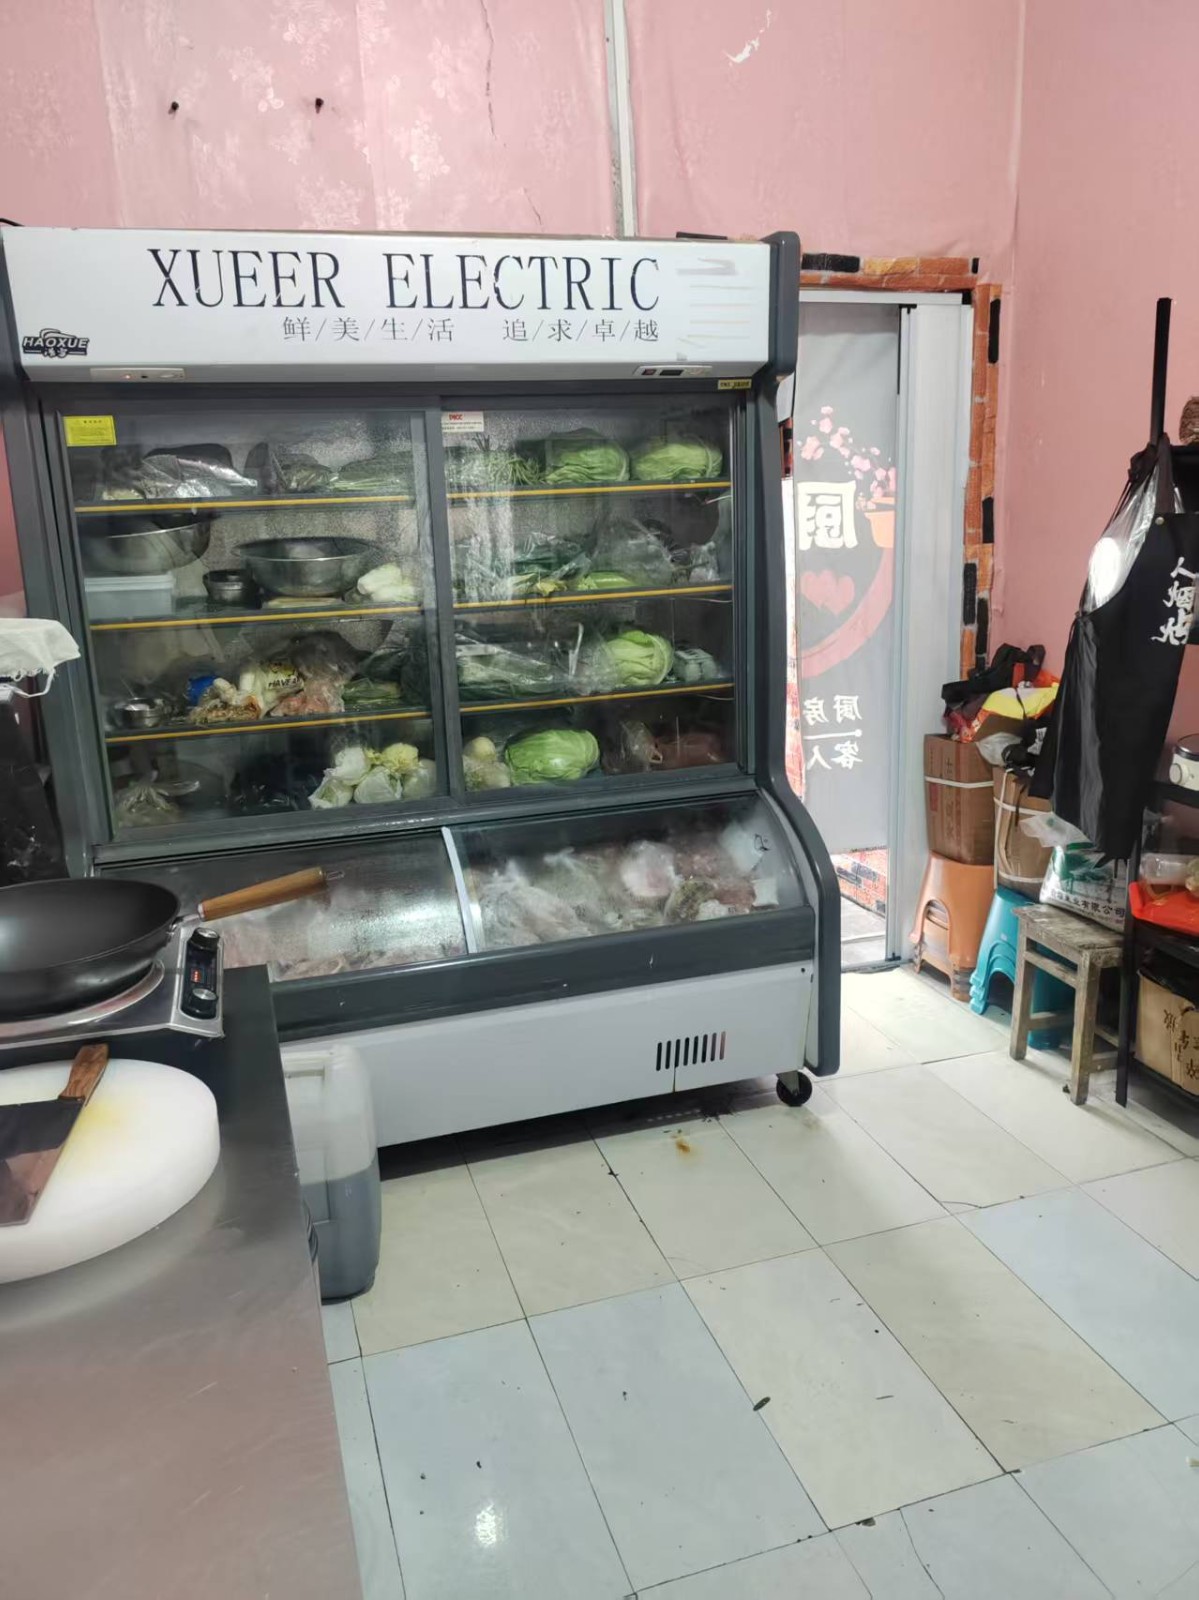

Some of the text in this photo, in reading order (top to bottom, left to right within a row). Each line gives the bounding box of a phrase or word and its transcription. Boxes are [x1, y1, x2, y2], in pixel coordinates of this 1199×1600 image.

[147, 248, 659, 311] XUEER ELECTRIC
[23, 337, 89, 348] HAOXUE
